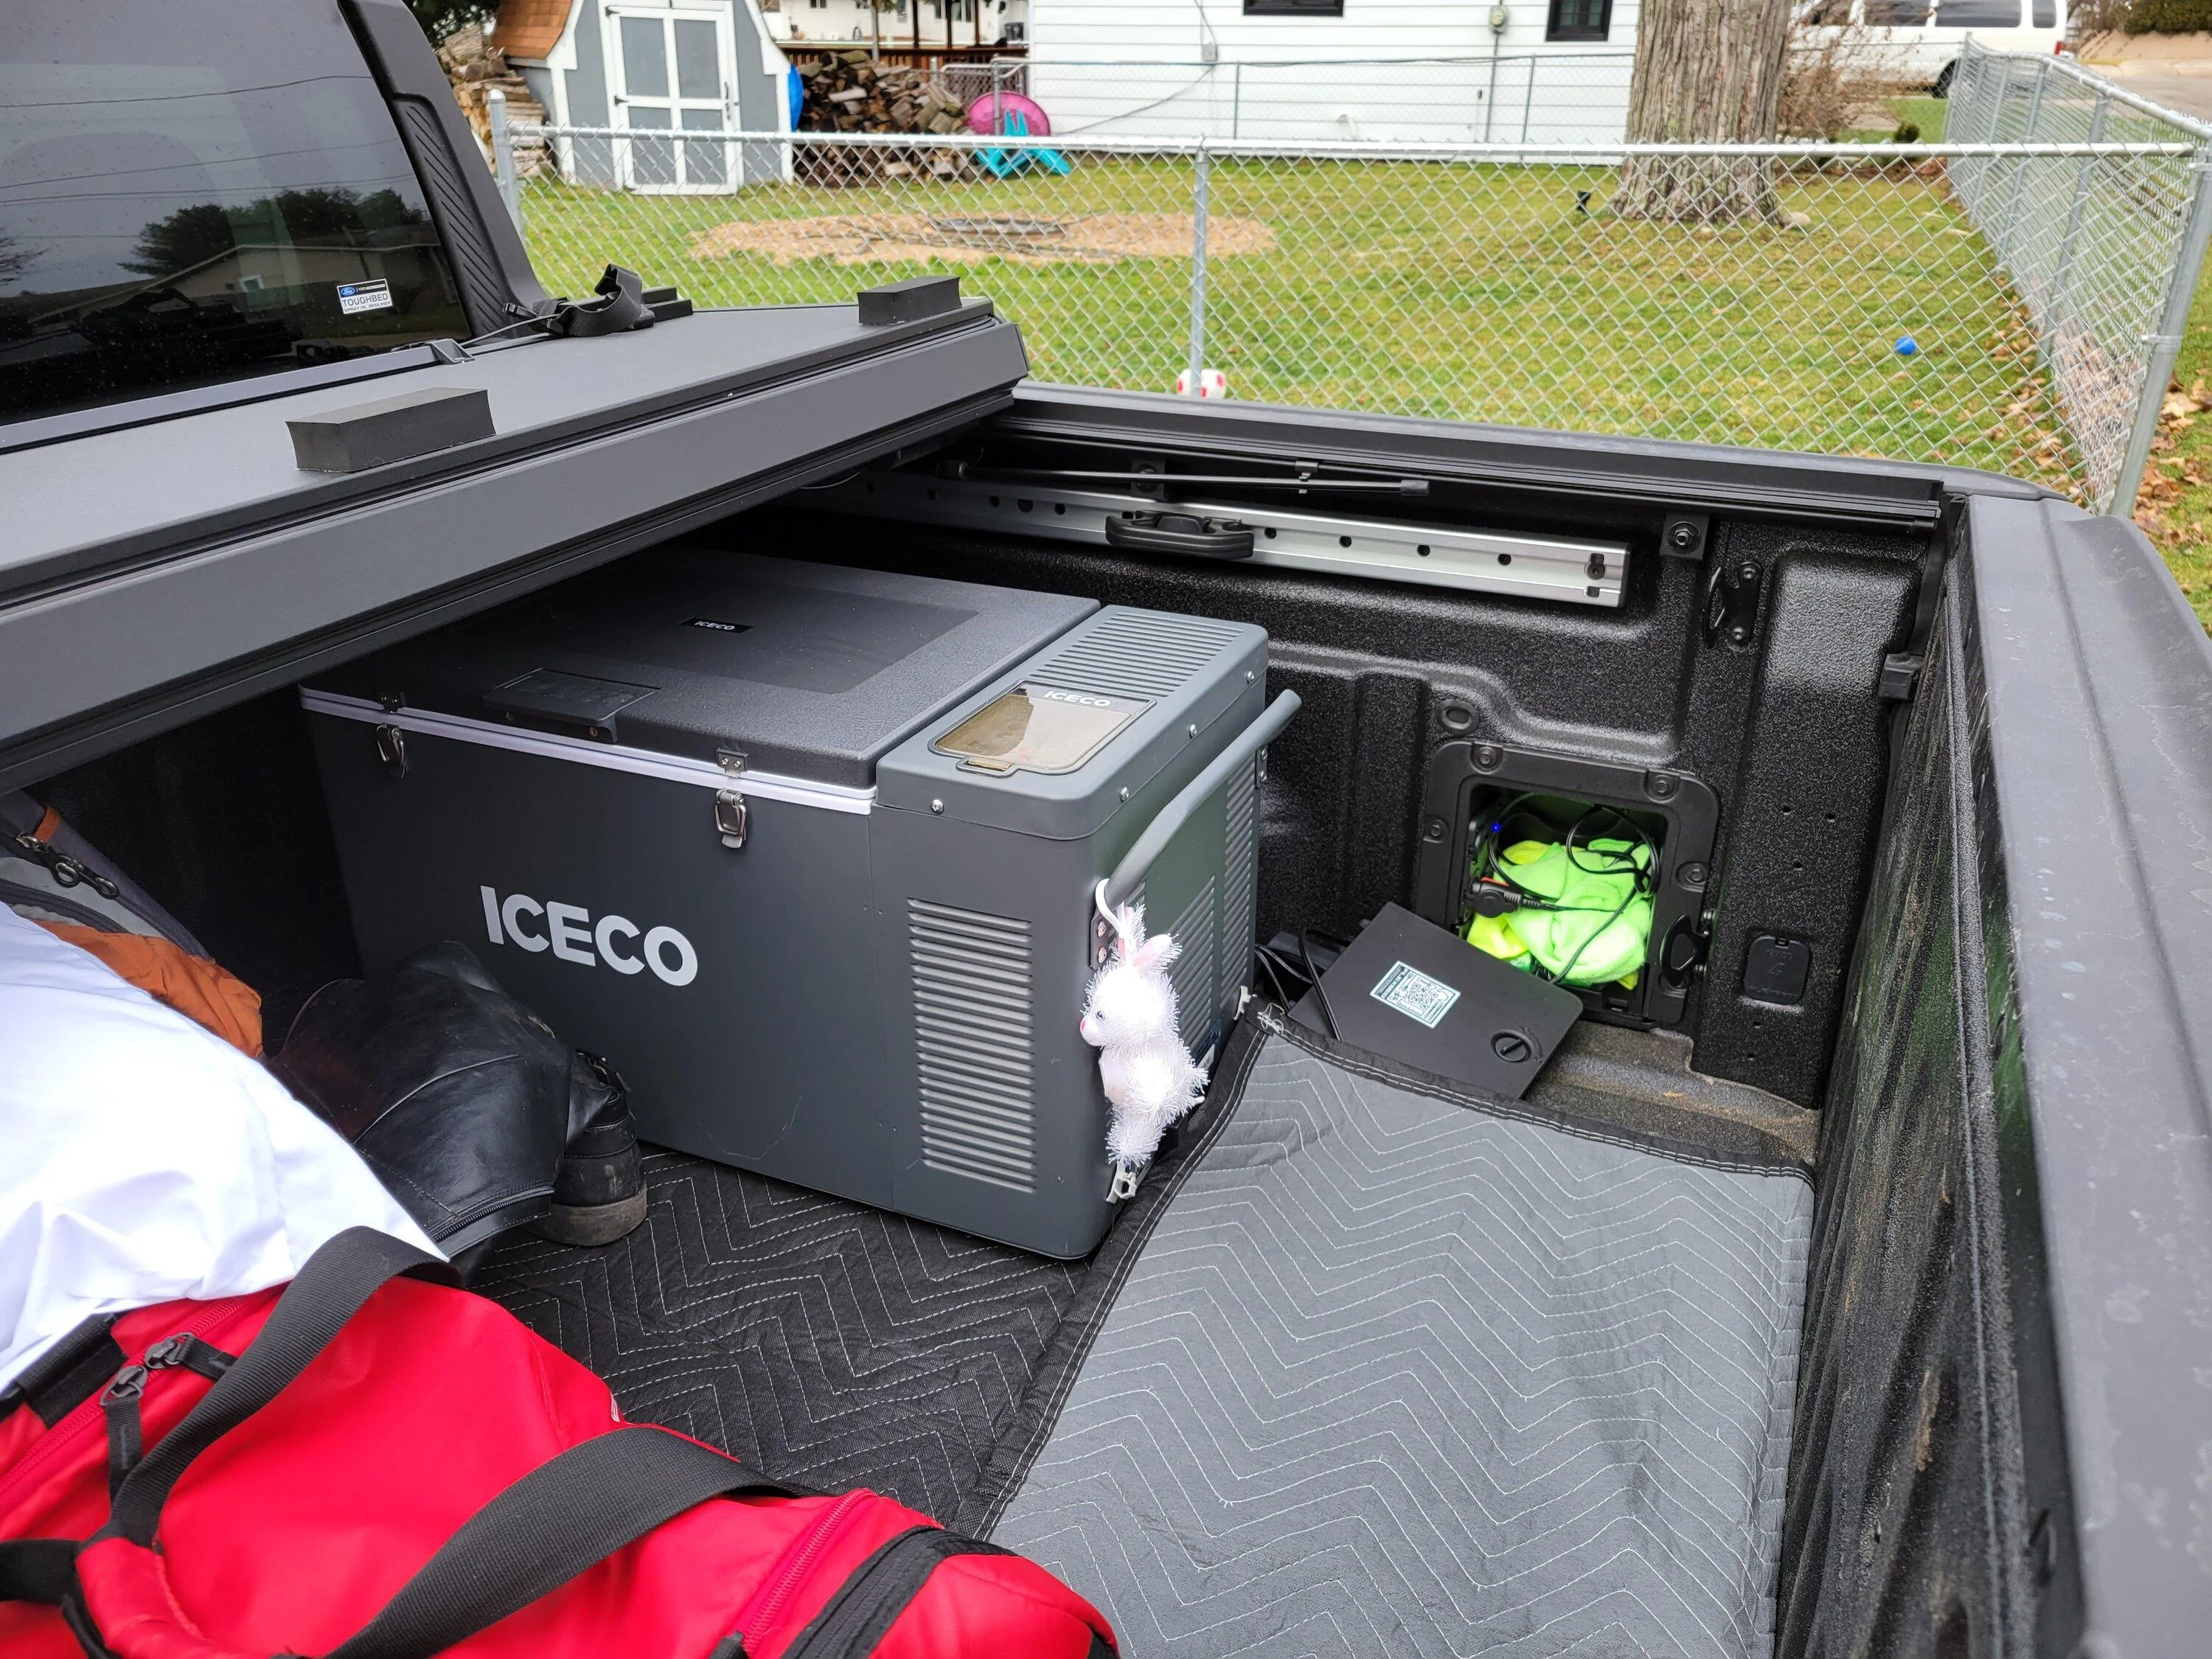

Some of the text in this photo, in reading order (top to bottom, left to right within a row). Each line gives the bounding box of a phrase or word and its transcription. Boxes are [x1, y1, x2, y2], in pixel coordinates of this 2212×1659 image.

[342, 293, 389, 307] TOUGHBED
[694, 621, 735, 630] ICECO
[1043, 690, 1111, 707] ICECO
[480, 885, 698, 987] ICECO
